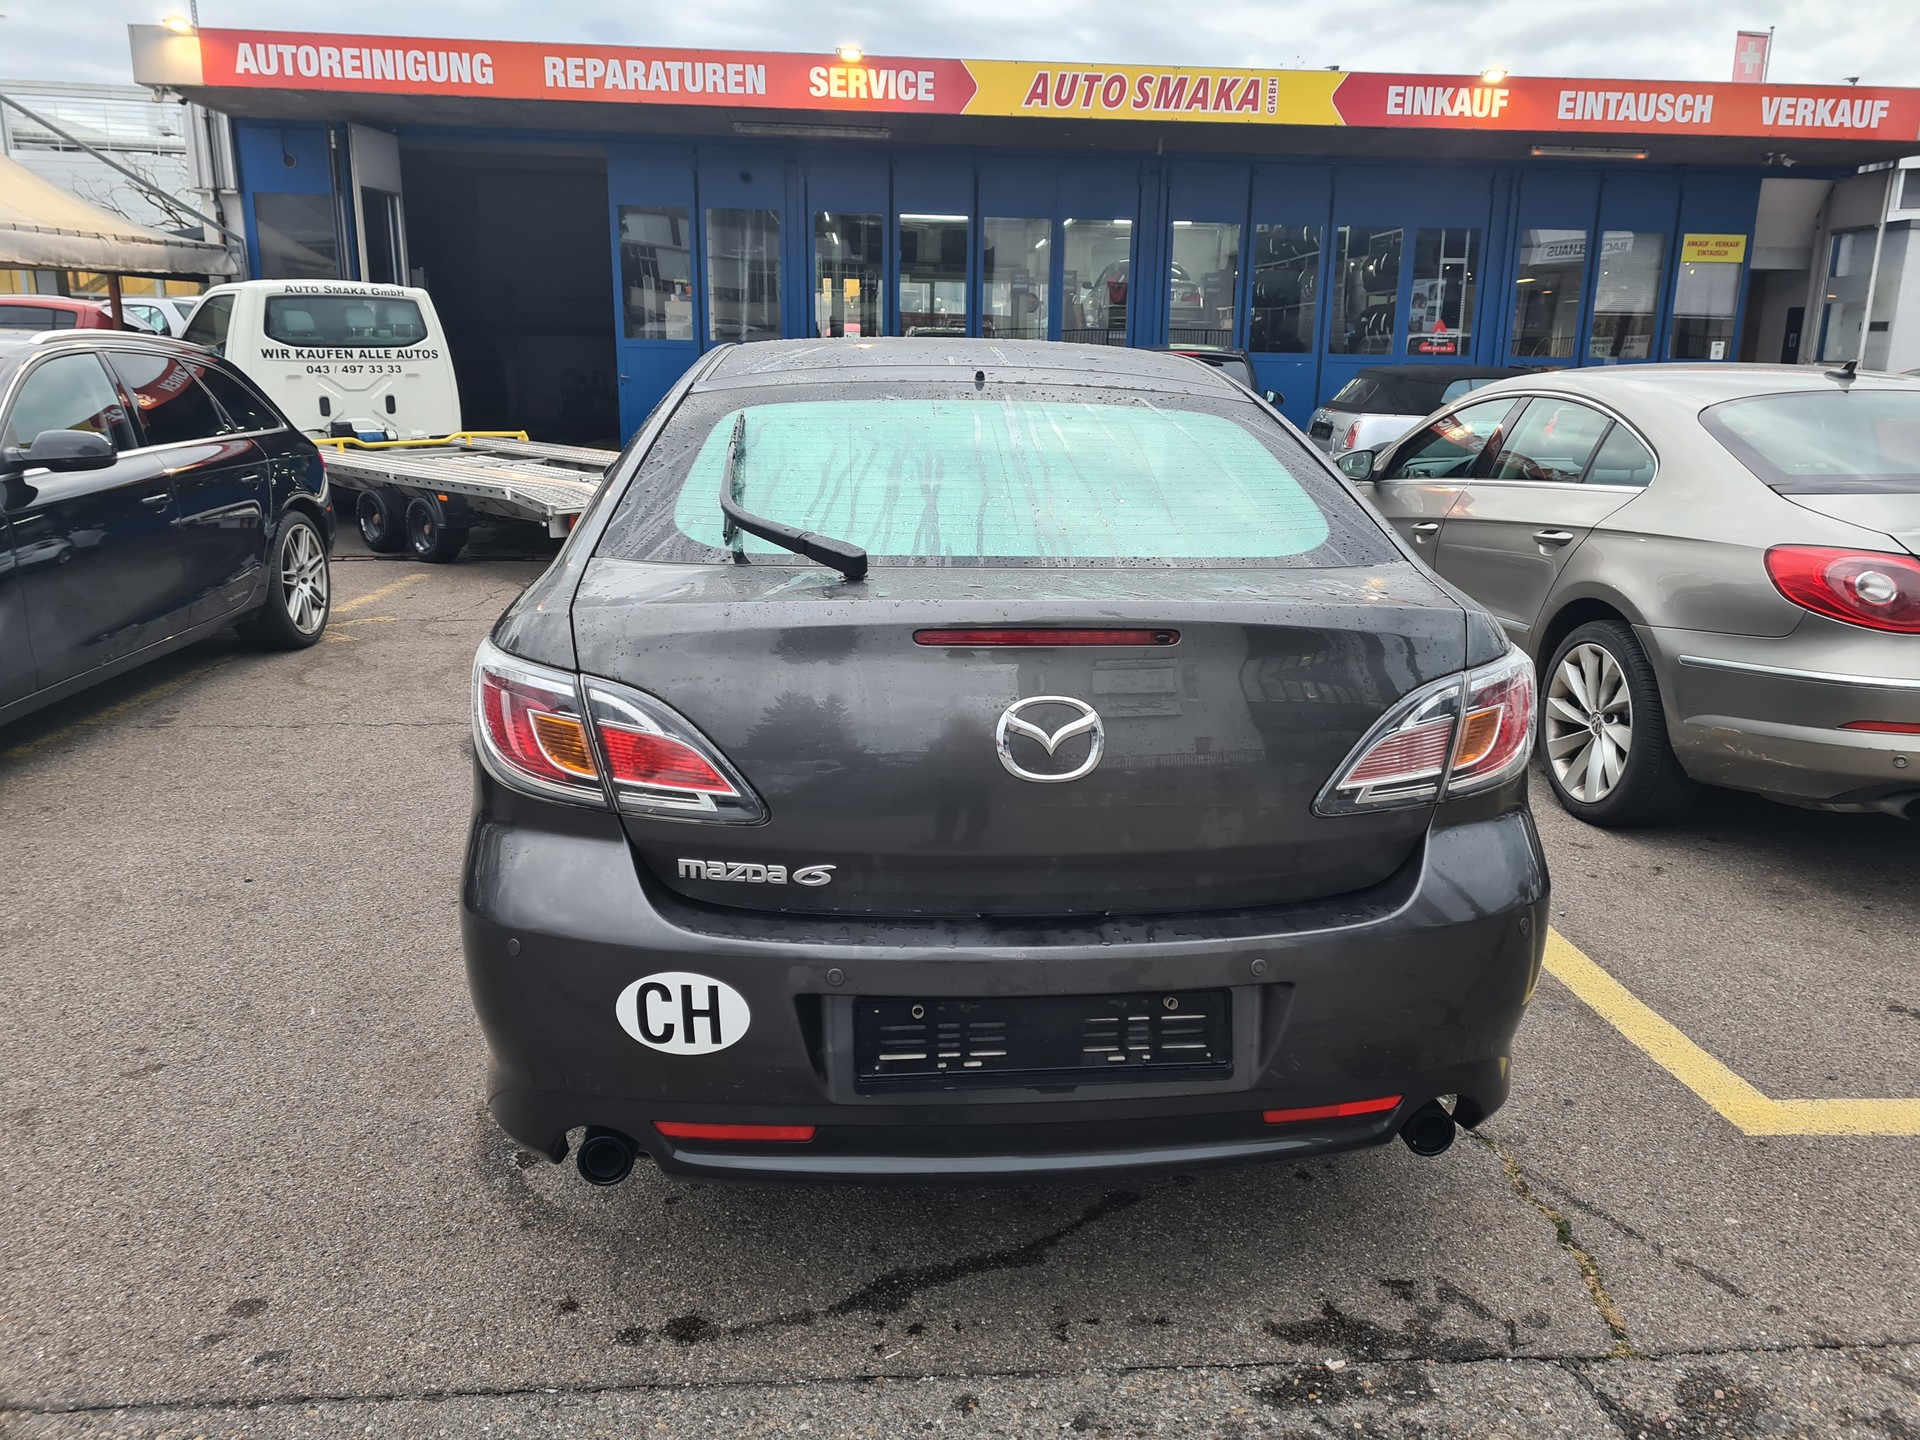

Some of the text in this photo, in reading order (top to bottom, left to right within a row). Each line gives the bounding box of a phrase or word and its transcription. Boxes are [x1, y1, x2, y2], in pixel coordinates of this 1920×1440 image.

[235, 42, 494, 85] AUTOREINIGUNG
[543, 56, 766, 95] REPARATUREN
[808, 66, 935, 102] SERVICE
[1266, 77, 1278, 115] GMBH
[1386, 85, 1509, 119] EINKAUF
[1557, 90, 1713, 124] EINTAUSCH
[1761, 96, 1889, 129] VERKAUF
[1687, 240, 1710, 248] ANKAUF
[284, 285, 405, 297] AUTO SMAKA GmbH
[260, 348, 439, 359] WIR KAUFEN ALLE AUTOS
[306, 365, 330, 374] 043
[341, 365, 364, 374] 497
[369, 365, 383, 374] 33
[387, 365, 402, 374] 33
[792, 864, 837, 887] 6
[635, 981, 723, 1045] CH
